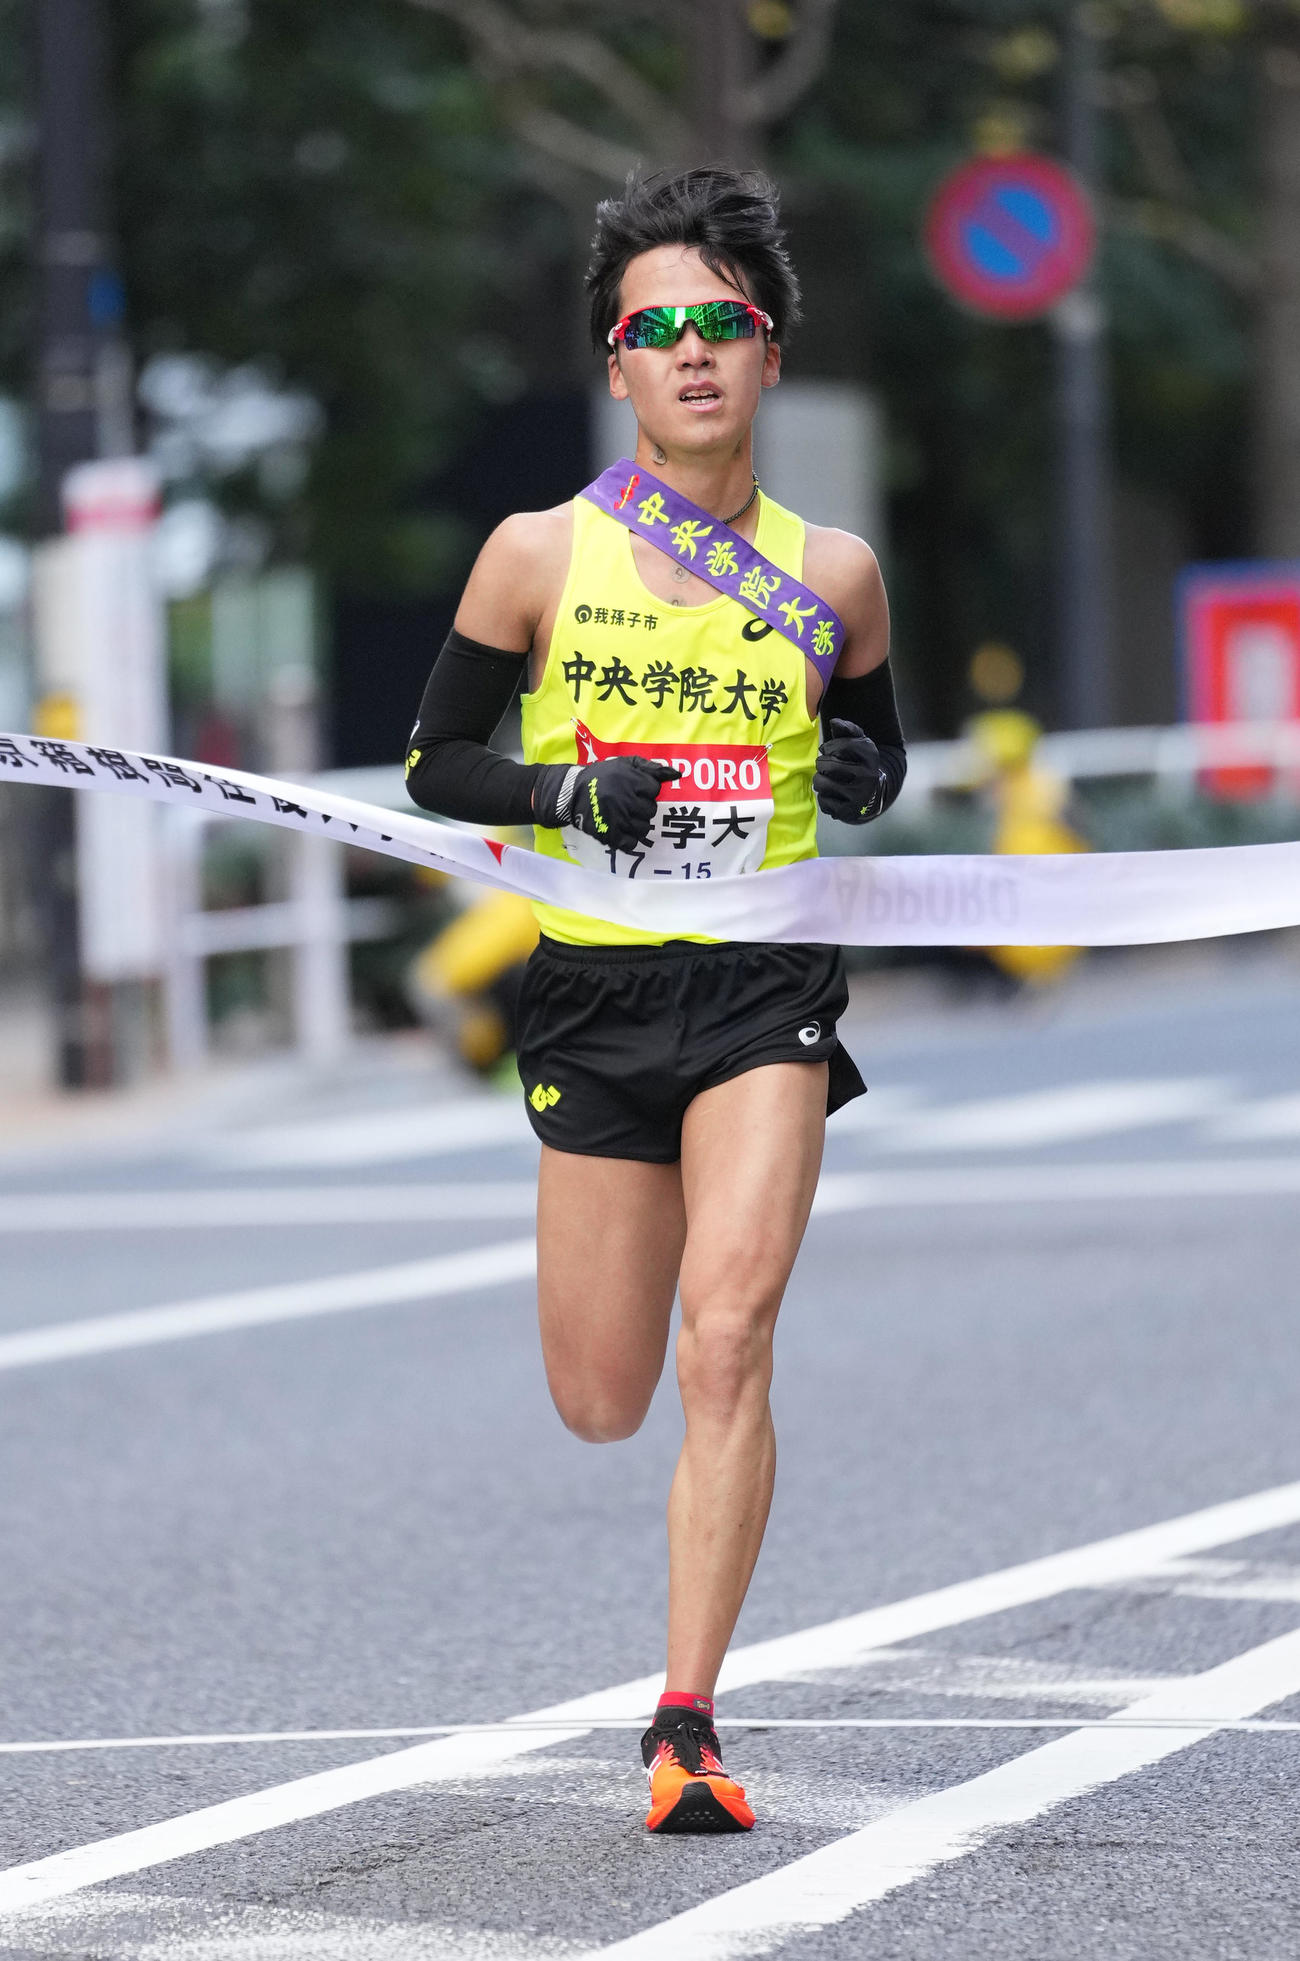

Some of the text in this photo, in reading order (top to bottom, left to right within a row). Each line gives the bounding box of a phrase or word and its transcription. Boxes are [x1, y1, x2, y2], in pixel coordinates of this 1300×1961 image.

[637, 491, 835, 656] 中央学院大学
[594, 607, 659, 631] 我孫子市
[561, 650, 789, 727] 中央学院大学
[605, 756, 761, 791] PORO
